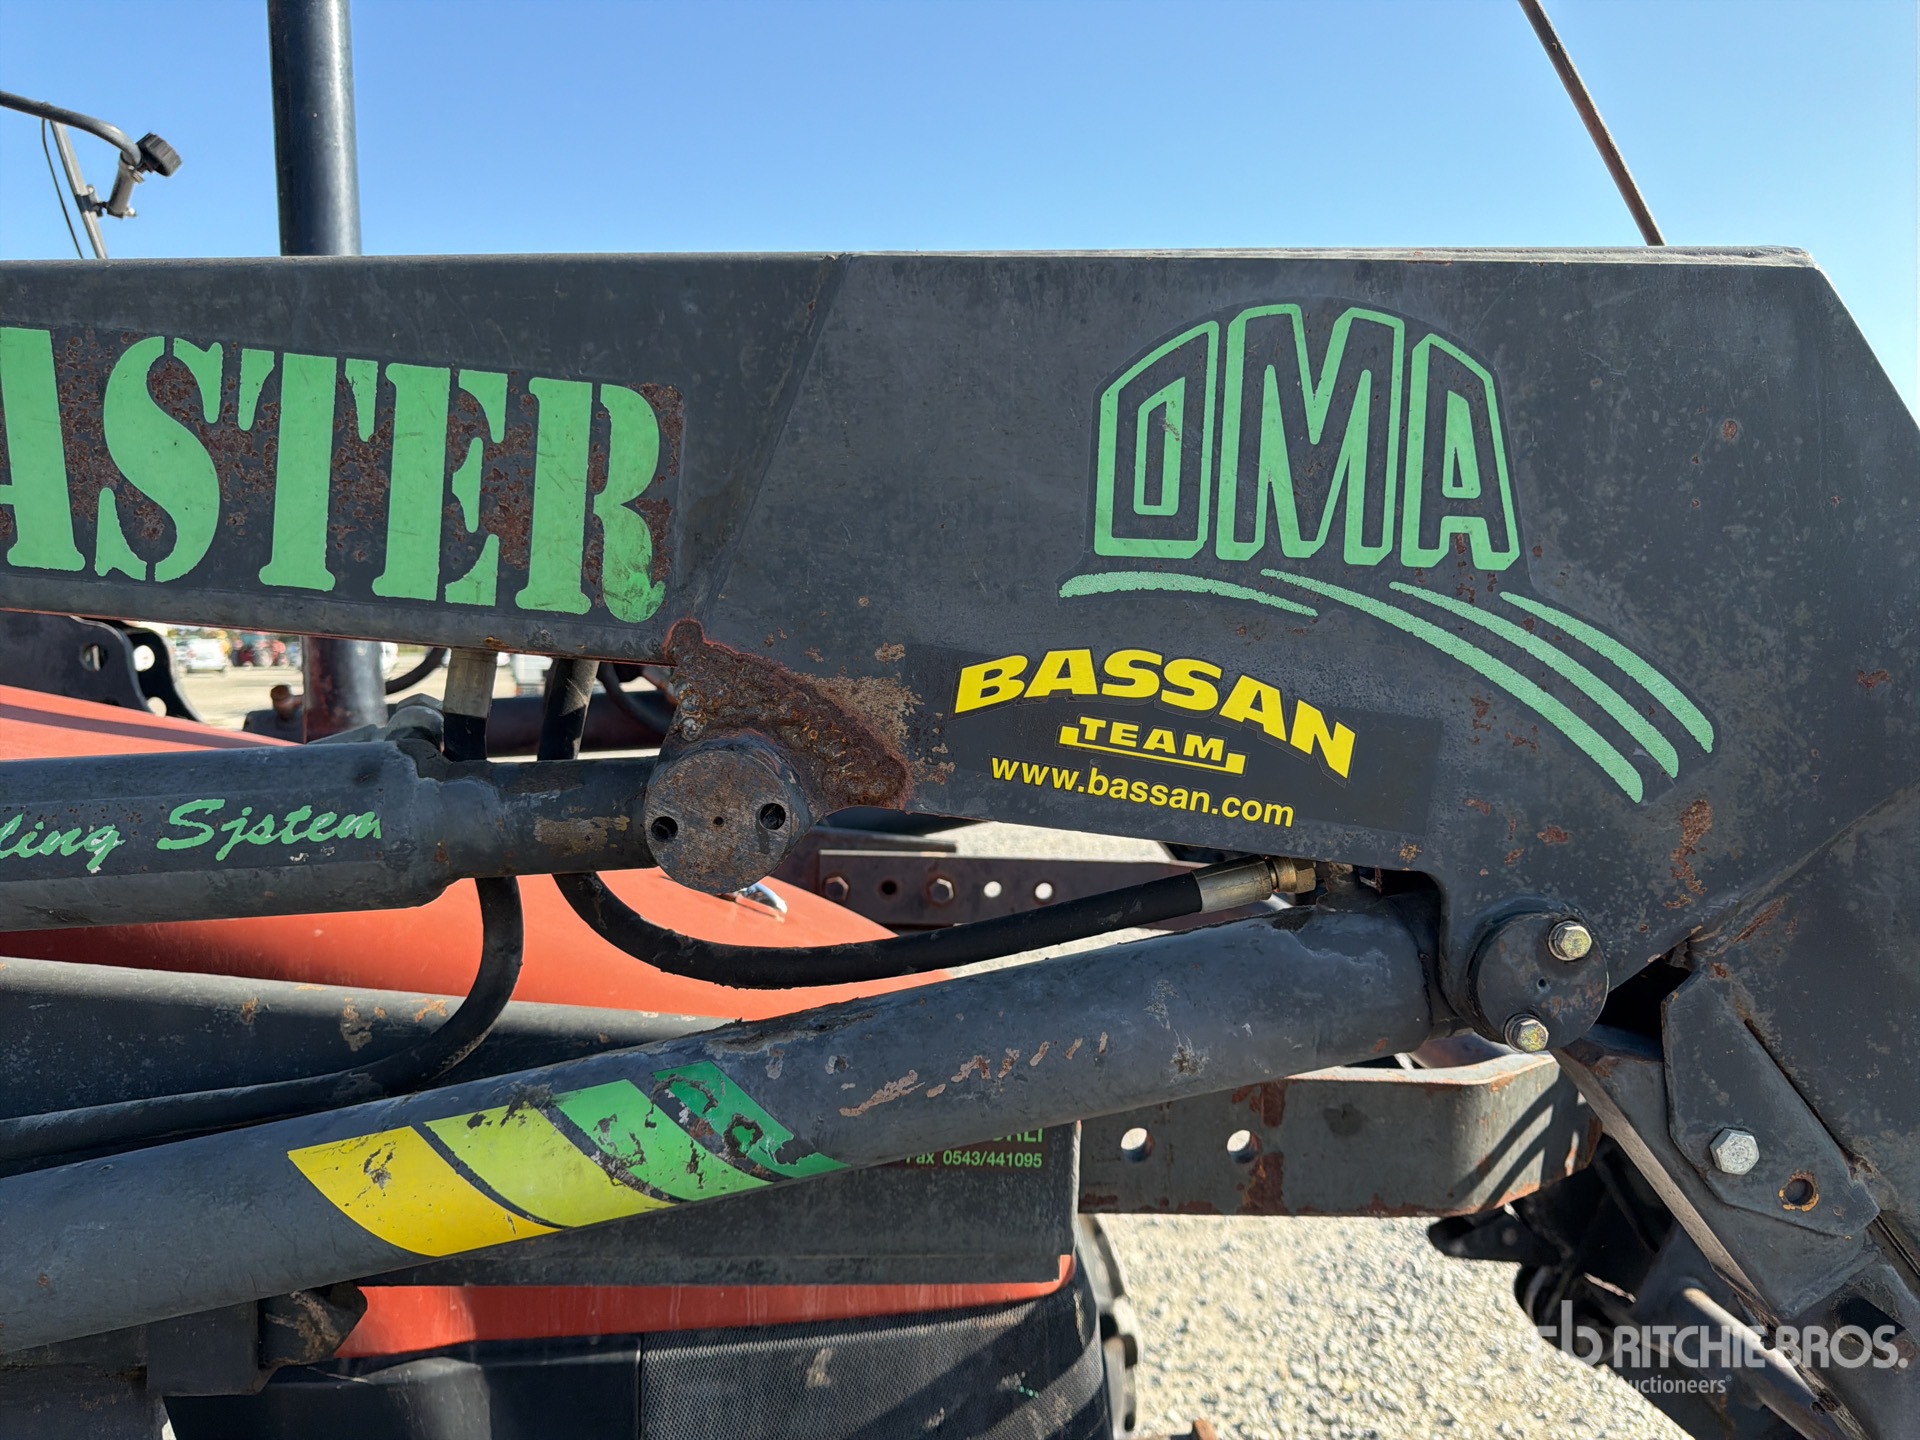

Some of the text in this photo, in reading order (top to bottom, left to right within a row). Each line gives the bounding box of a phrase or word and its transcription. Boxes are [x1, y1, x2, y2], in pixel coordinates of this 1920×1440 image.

[1095, 303, 1521, 570] OMA
[955, 649, 1356, 778] BASSAN
[1080, 716, 1225, 762] TEAM
[992, 758, 1294, 828] www.bassan.com
[906, 1150, 1042, 1168] ax 0543/441095
